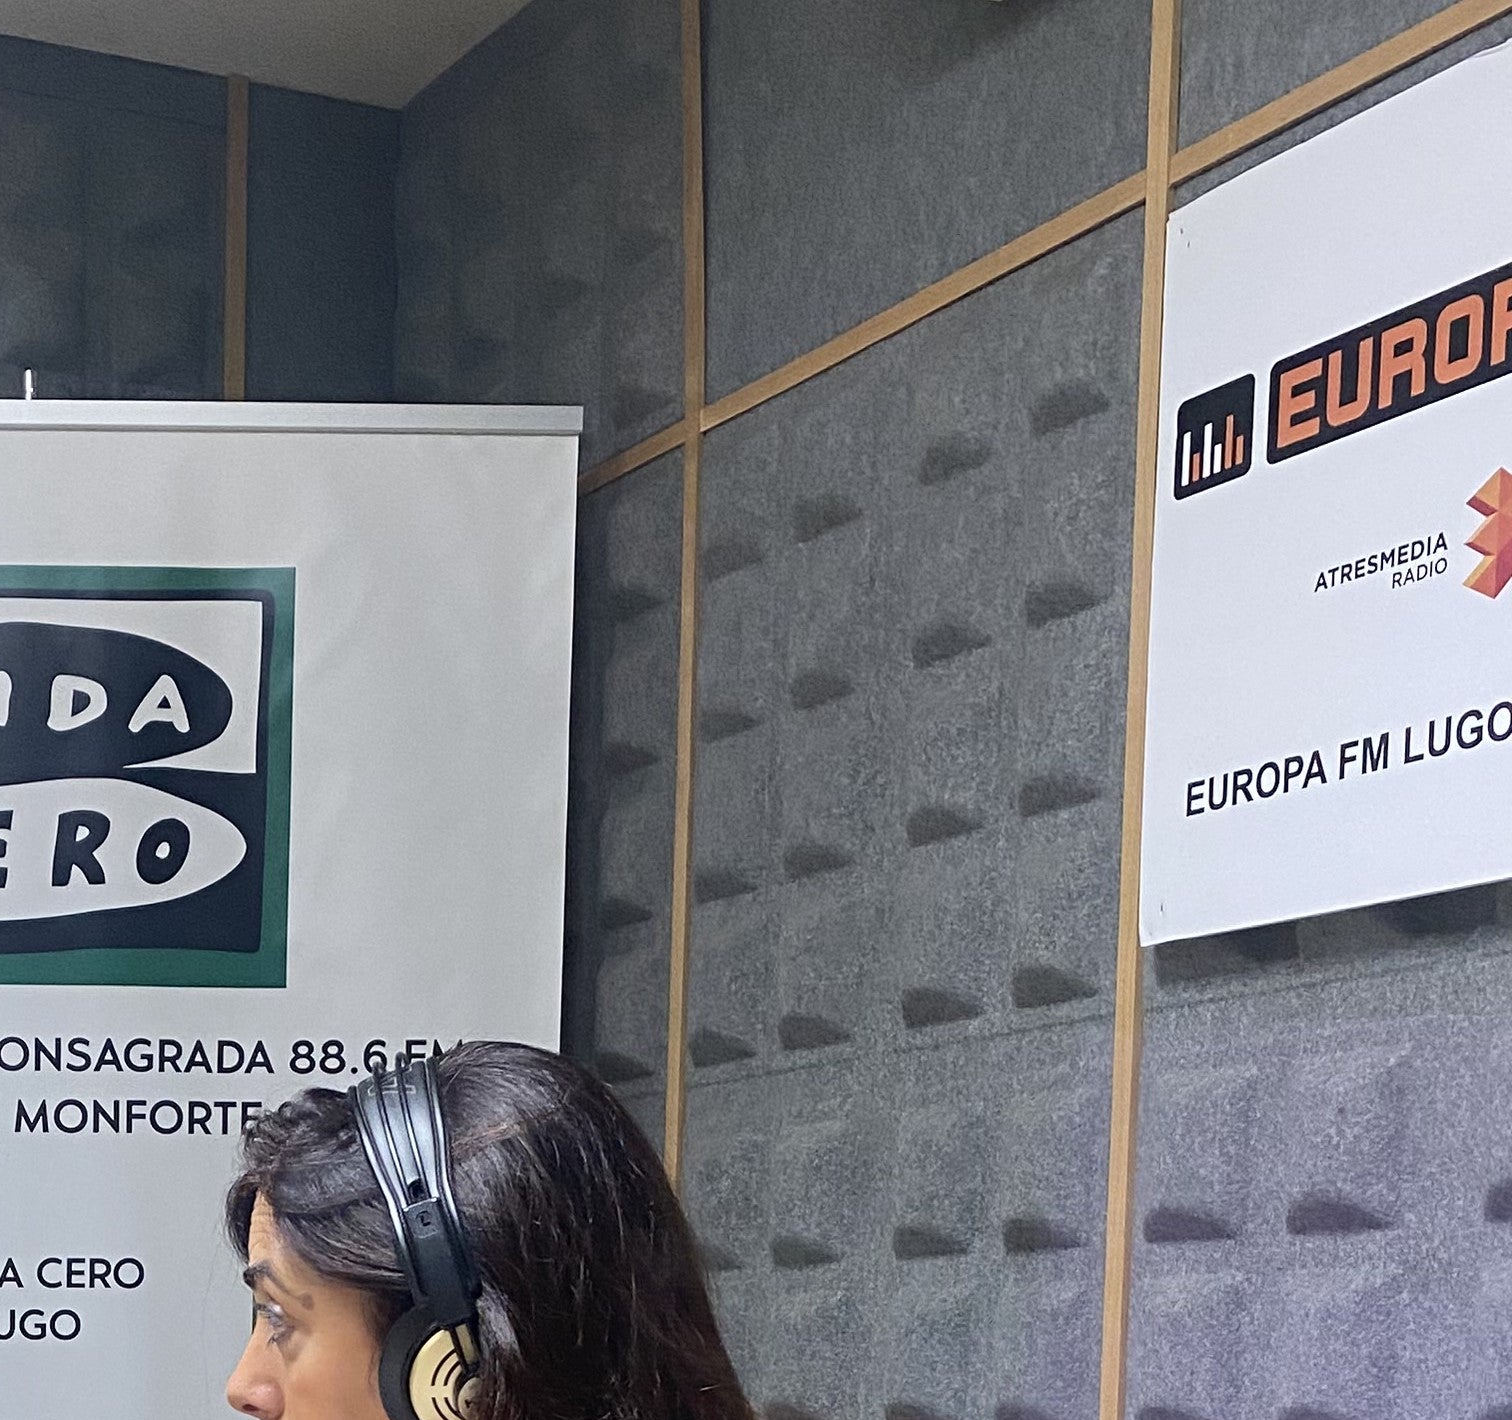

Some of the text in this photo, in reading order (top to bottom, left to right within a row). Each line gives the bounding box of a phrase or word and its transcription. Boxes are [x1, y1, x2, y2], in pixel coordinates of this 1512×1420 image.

[1314, 532, 1448, 593] ATRESMEDIA
[1391, 558, 1448, 590] RADIO
[1185, 700, 1512, 818] EUROPA FM LUGO
[289, 1039, 387, 1075] 88.6
[14, 1098, 262, 1135] MONFORTE
[36, 1257, 145, 1289] CERO
